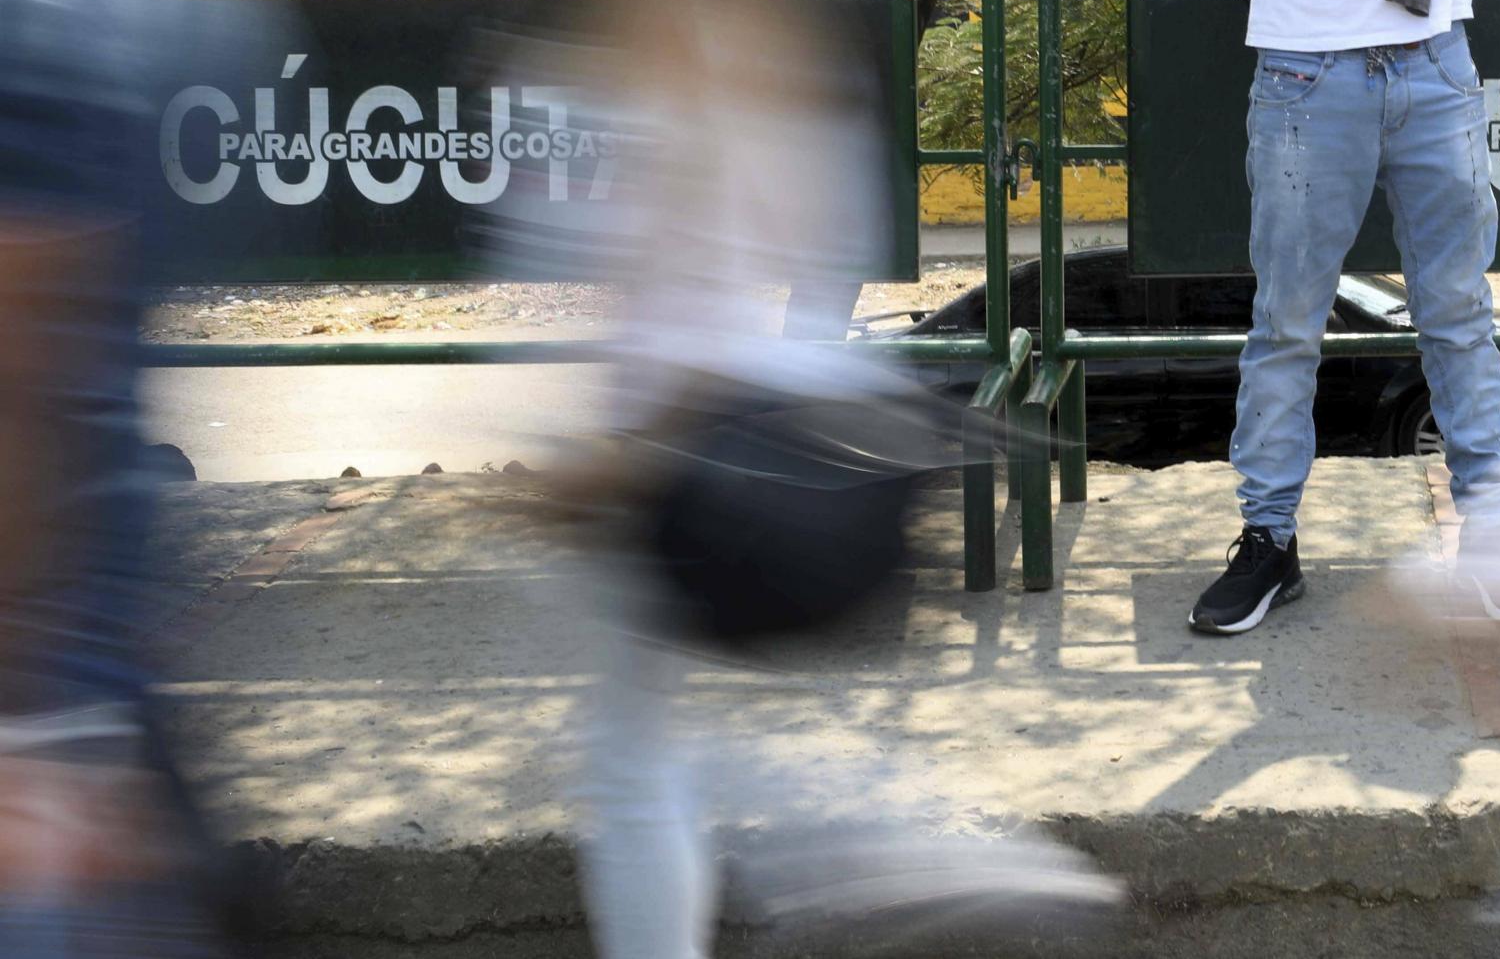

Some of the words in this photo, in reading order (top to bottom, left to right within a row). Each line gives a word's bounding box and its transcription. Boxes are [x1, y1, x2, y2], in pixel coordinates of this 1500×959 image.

[219, 132, 312, 161] PARA
[321, 132, 491, 161] GRANDES
[502, 131, 617, 161] COSAS
